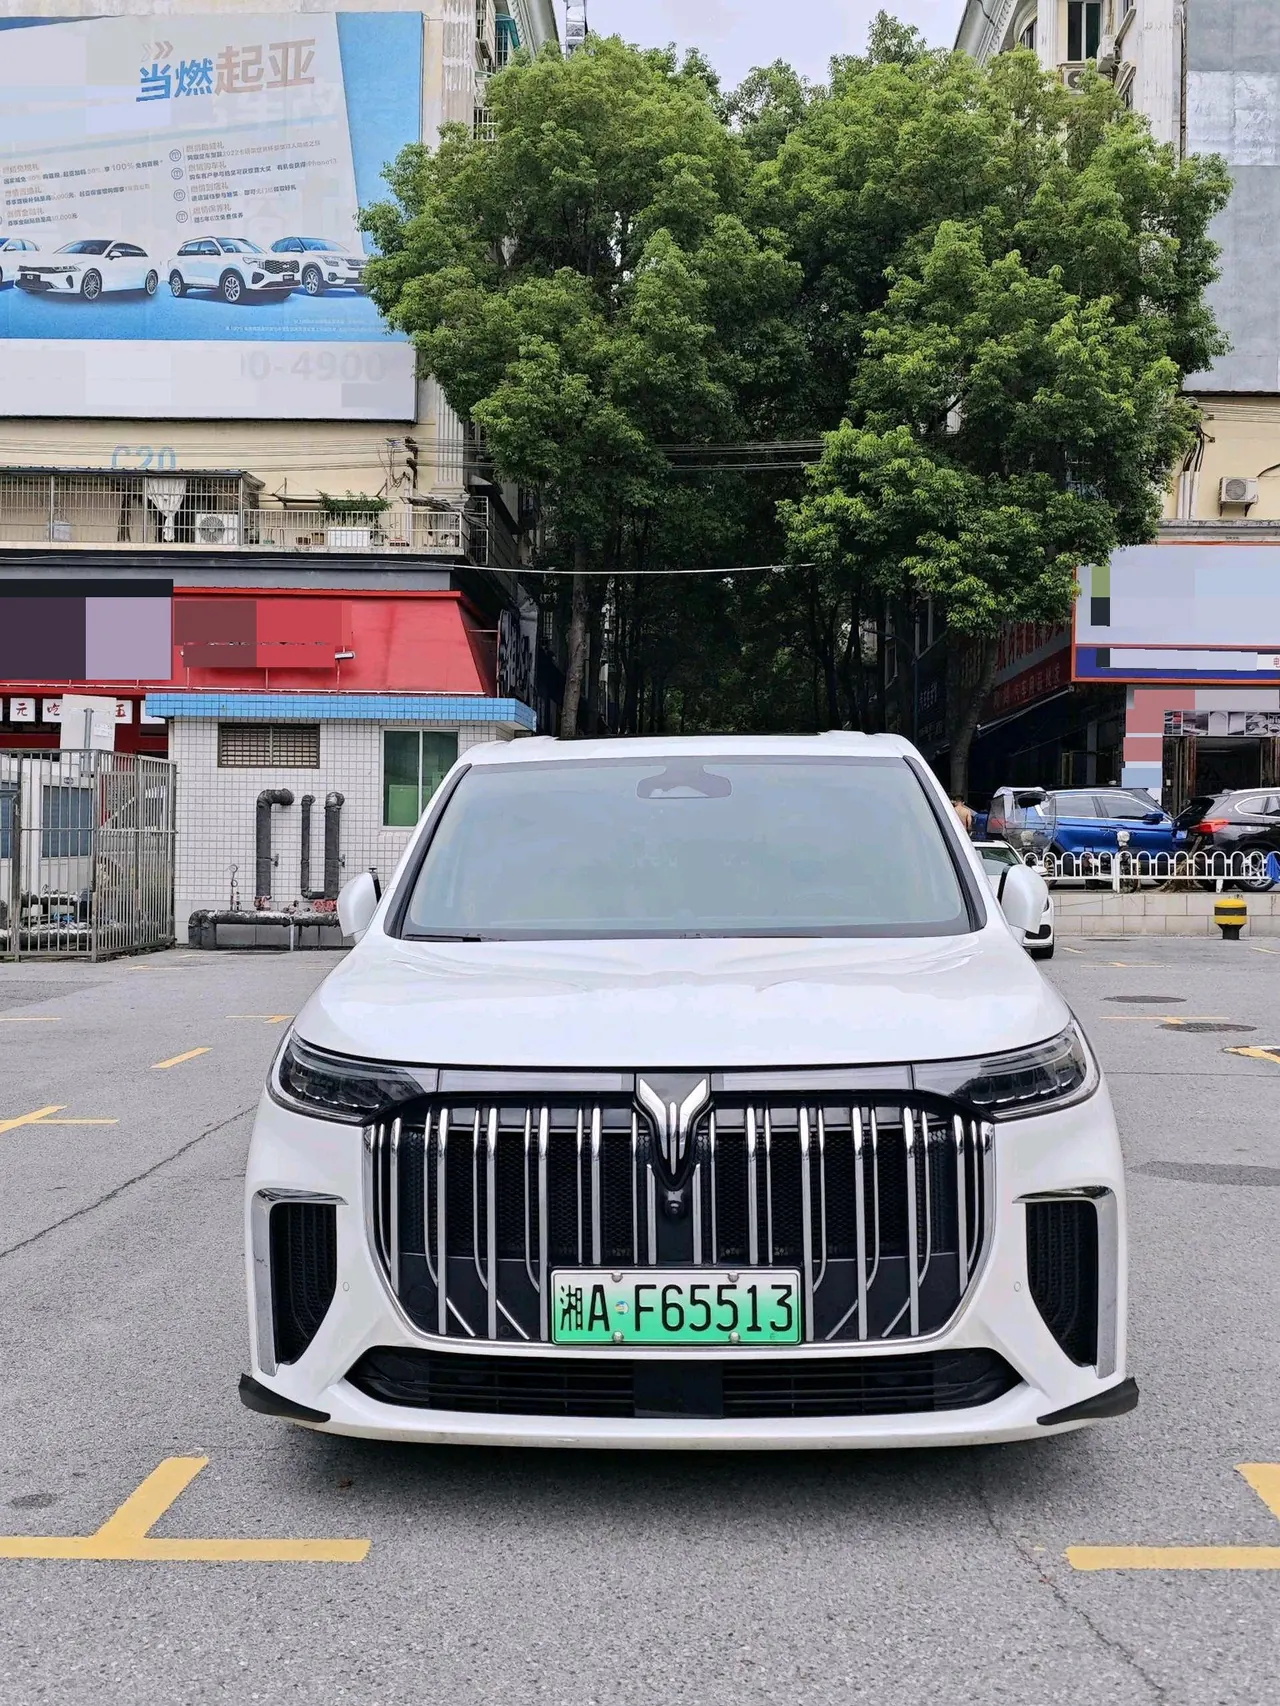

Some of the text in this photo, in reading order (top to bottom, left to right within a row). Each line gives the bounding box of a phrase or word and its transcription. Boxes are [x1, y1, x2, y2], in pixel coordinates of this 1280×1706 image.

[136, 38, 316, 102] 当燃起亚
[560, 1284, 793, 1332] 湘A F65513
